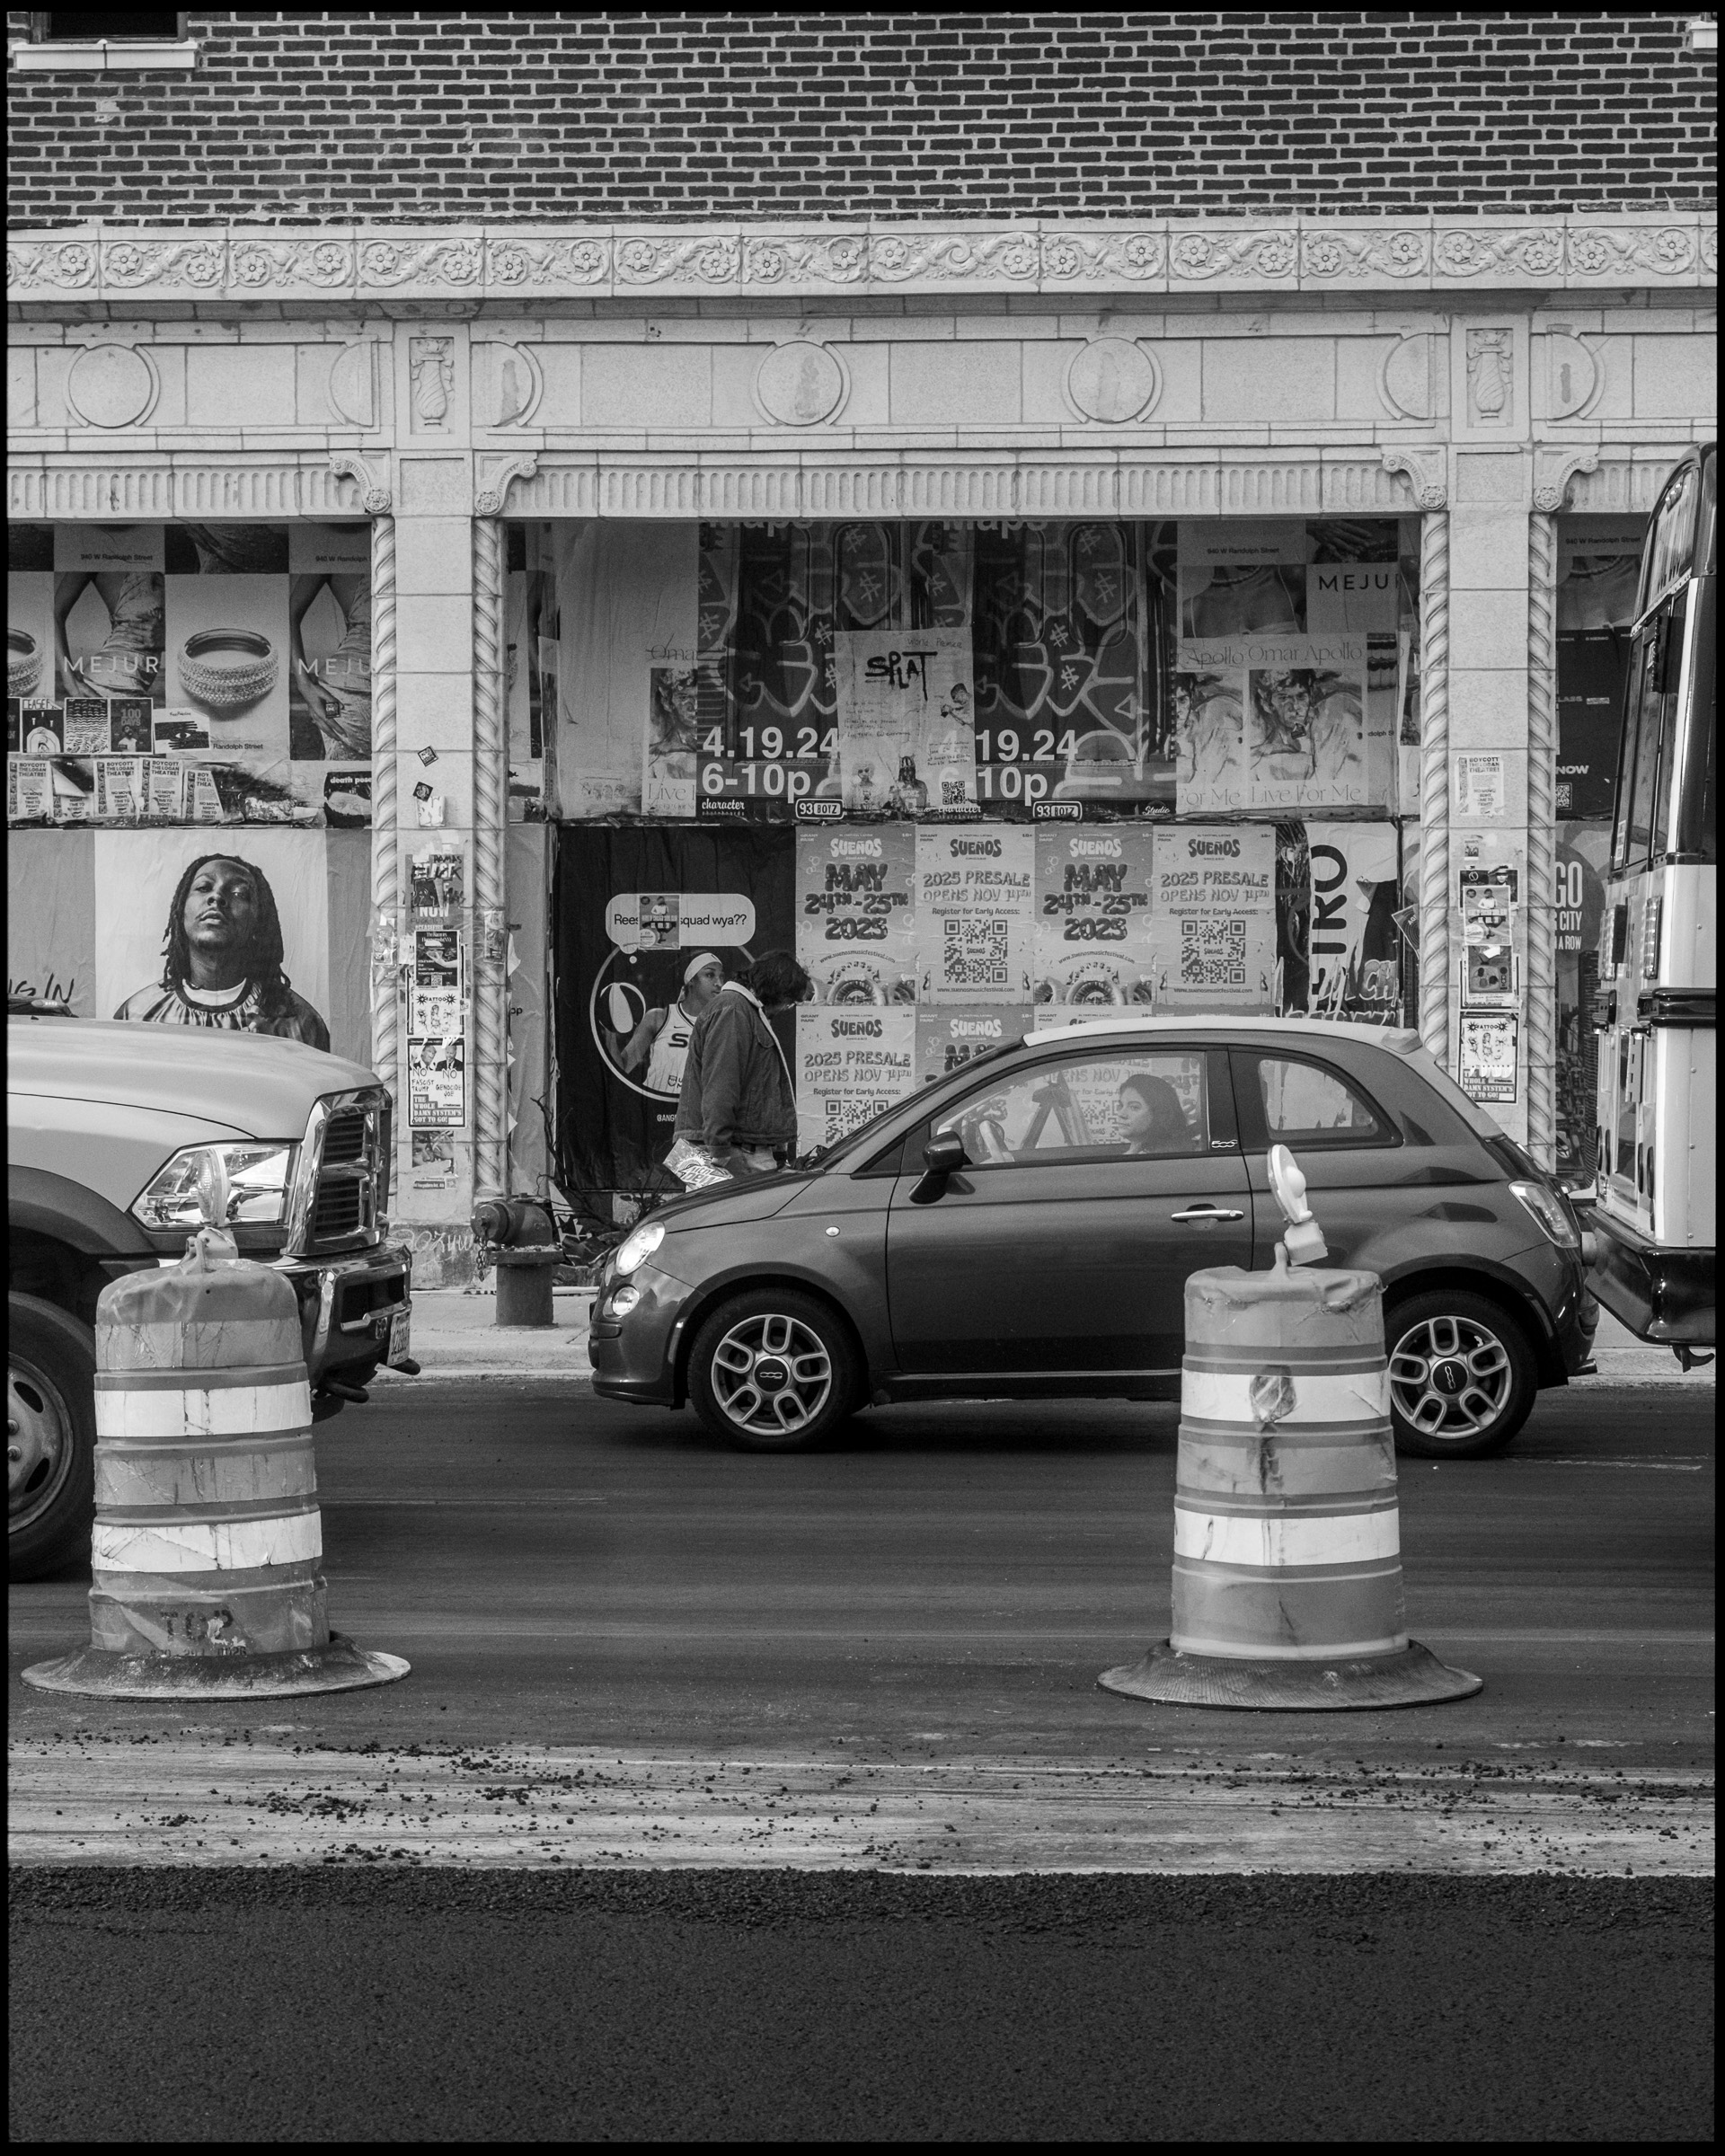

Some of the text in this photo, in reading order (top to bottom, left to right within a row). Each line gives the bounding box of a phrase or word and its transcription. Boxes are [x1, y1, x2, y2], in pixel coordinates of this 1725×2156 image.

[1229, 547, 1260, 555] Randolph
[1318, 574, 1399, 591] MEJU
[1248, 642, 1363, 665] Omar Apollo
[64, 656, 160, 674] MEJUR
[120, 708, 141, 719] 100
[703, 726, 839, 758] 4.19.24
[330, 776, 353, 784] death
[702, 763, 810, 803] 6-10p
[1251, 785, 1361, 802] Live For Me
[702, 798, 746, 810] character
[800, 803, 812, 815] 93
[1037, 805, 1049, 817] 93
[830, 838, 882, 857] SUEÑOS
[950, 839, 1002, 857] SUEÑOS
[1069, 838, 1122, 857] SUEÑOS
[1188, 839, 1240, 857] SUEÑOS
[825, 862, 888, 892] MAY
[923, 870, 1031, 888] 2025 PRESALE
[1064, 863, 1128, 892] MAY
[1161, 870, 1269, 888] 2025 PRESALE
[924, 888, 969, 902] OPENS
[973, 888, 1001, 902] NOV
[1161, 888, 1206, 902] OPENS
[1210, 888, 1239, 902] NOV
[932, 907, 961, 916] Register
[975, 907, 994, 916] Early
[1170, 907, 1199, 916] Register
[1213, 908, 1232, 916] Early
[712, 915, 747, 929] wya??
[825, 917, 889, 941] 2025
[1559, 911, 1582, 931] CITY
[1565, 936, 1582, 950] ROW
[831, 1019, 882, 1038] SUEÑOS
[950, 1019, 1002, 1038] SUEÑOS
[804, 1050, 911, 1067] 2025 PRESALE
[804, 1069, 849, 1082] OPENS
[854, 1069, 880, 1082] NOV
[813, 1088, 842, 1097] Register
[855, 1088, 874, 1097] Early
